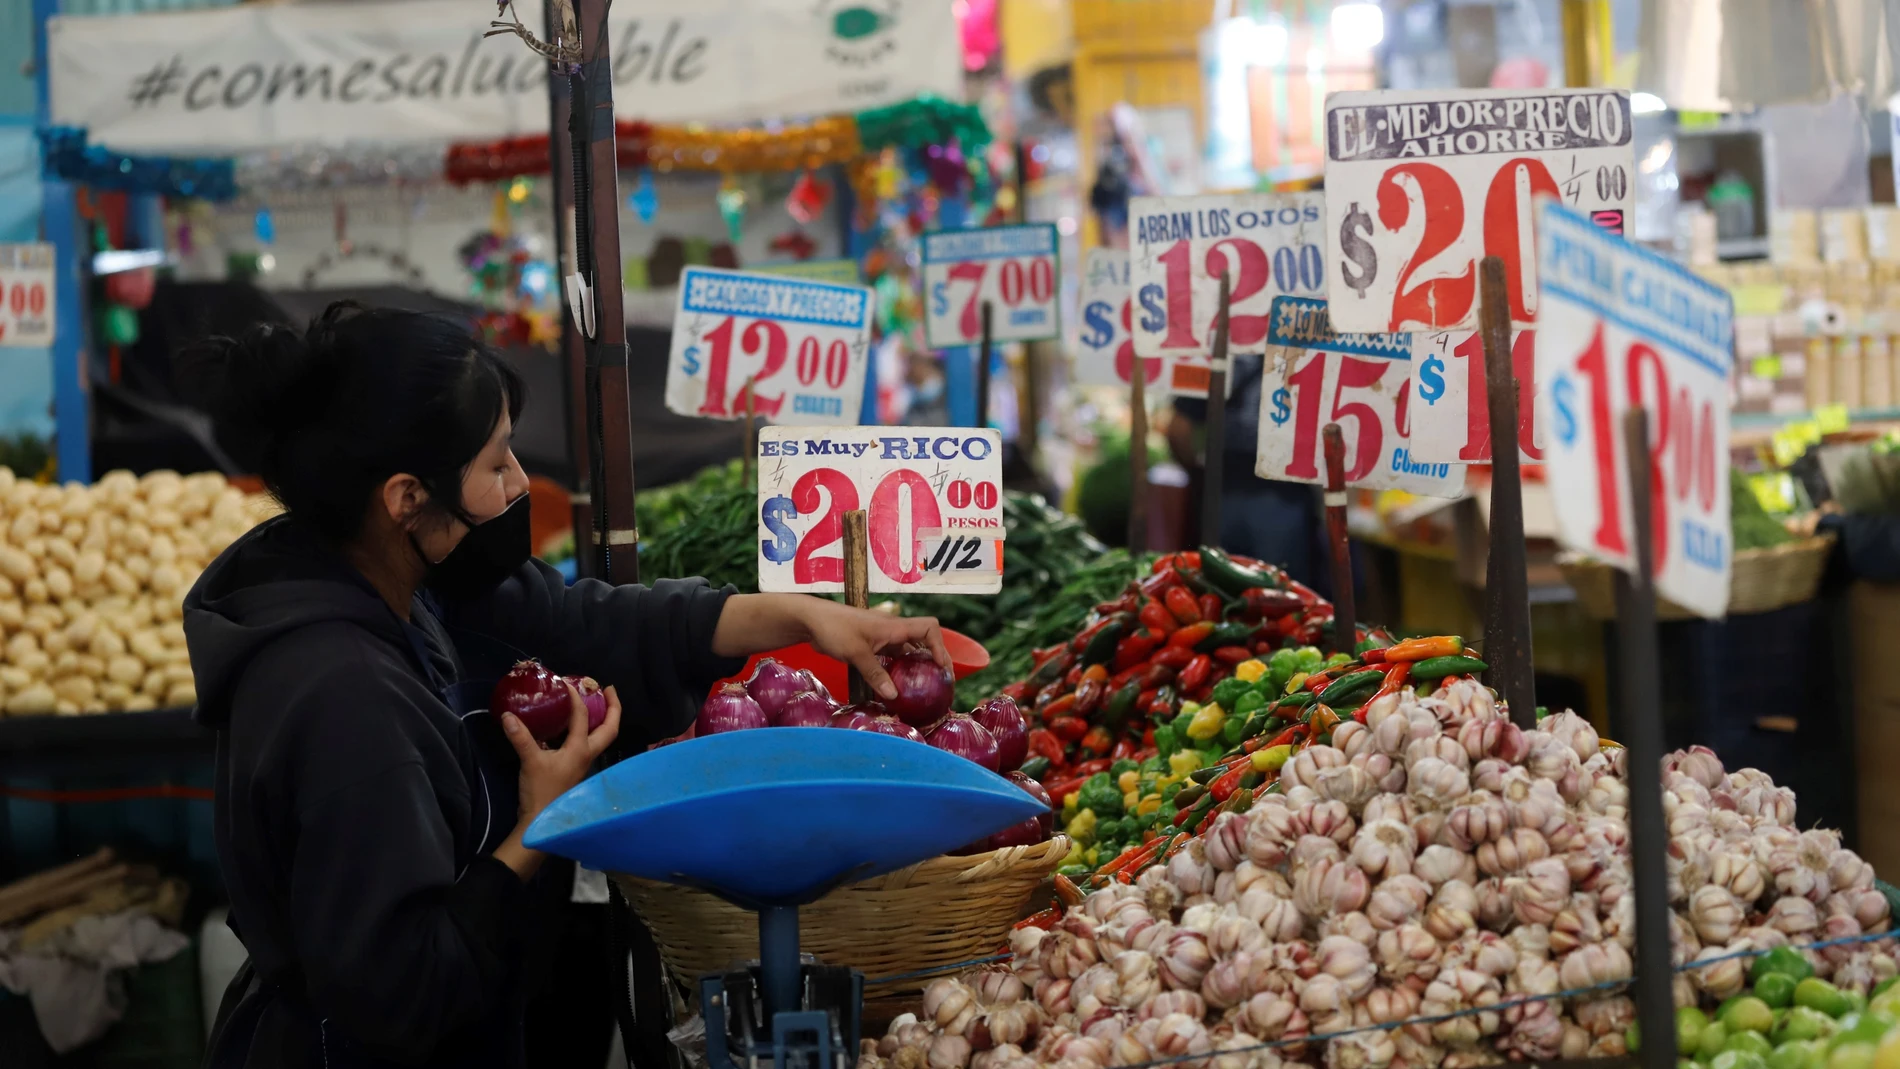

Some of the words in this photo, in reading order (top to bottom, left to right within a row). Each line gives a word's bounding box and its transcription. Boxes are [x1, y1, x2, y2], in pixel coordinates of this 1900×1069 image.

[130, 18, 706, 112] #comesaluble
[1399, 129, 1568, 159] AHORRE
[1138, 212, 1193, 245] ABRAN
[1198, 208, 1231, 238] LOS
[1236, 206, 1319, 229] OJOS
[759, 440, 799, 457] ES
[805, 439, 869, 458] Muy
[879, 436, 992, 460] RICO
[948, 516, 998, 528] PESOS
